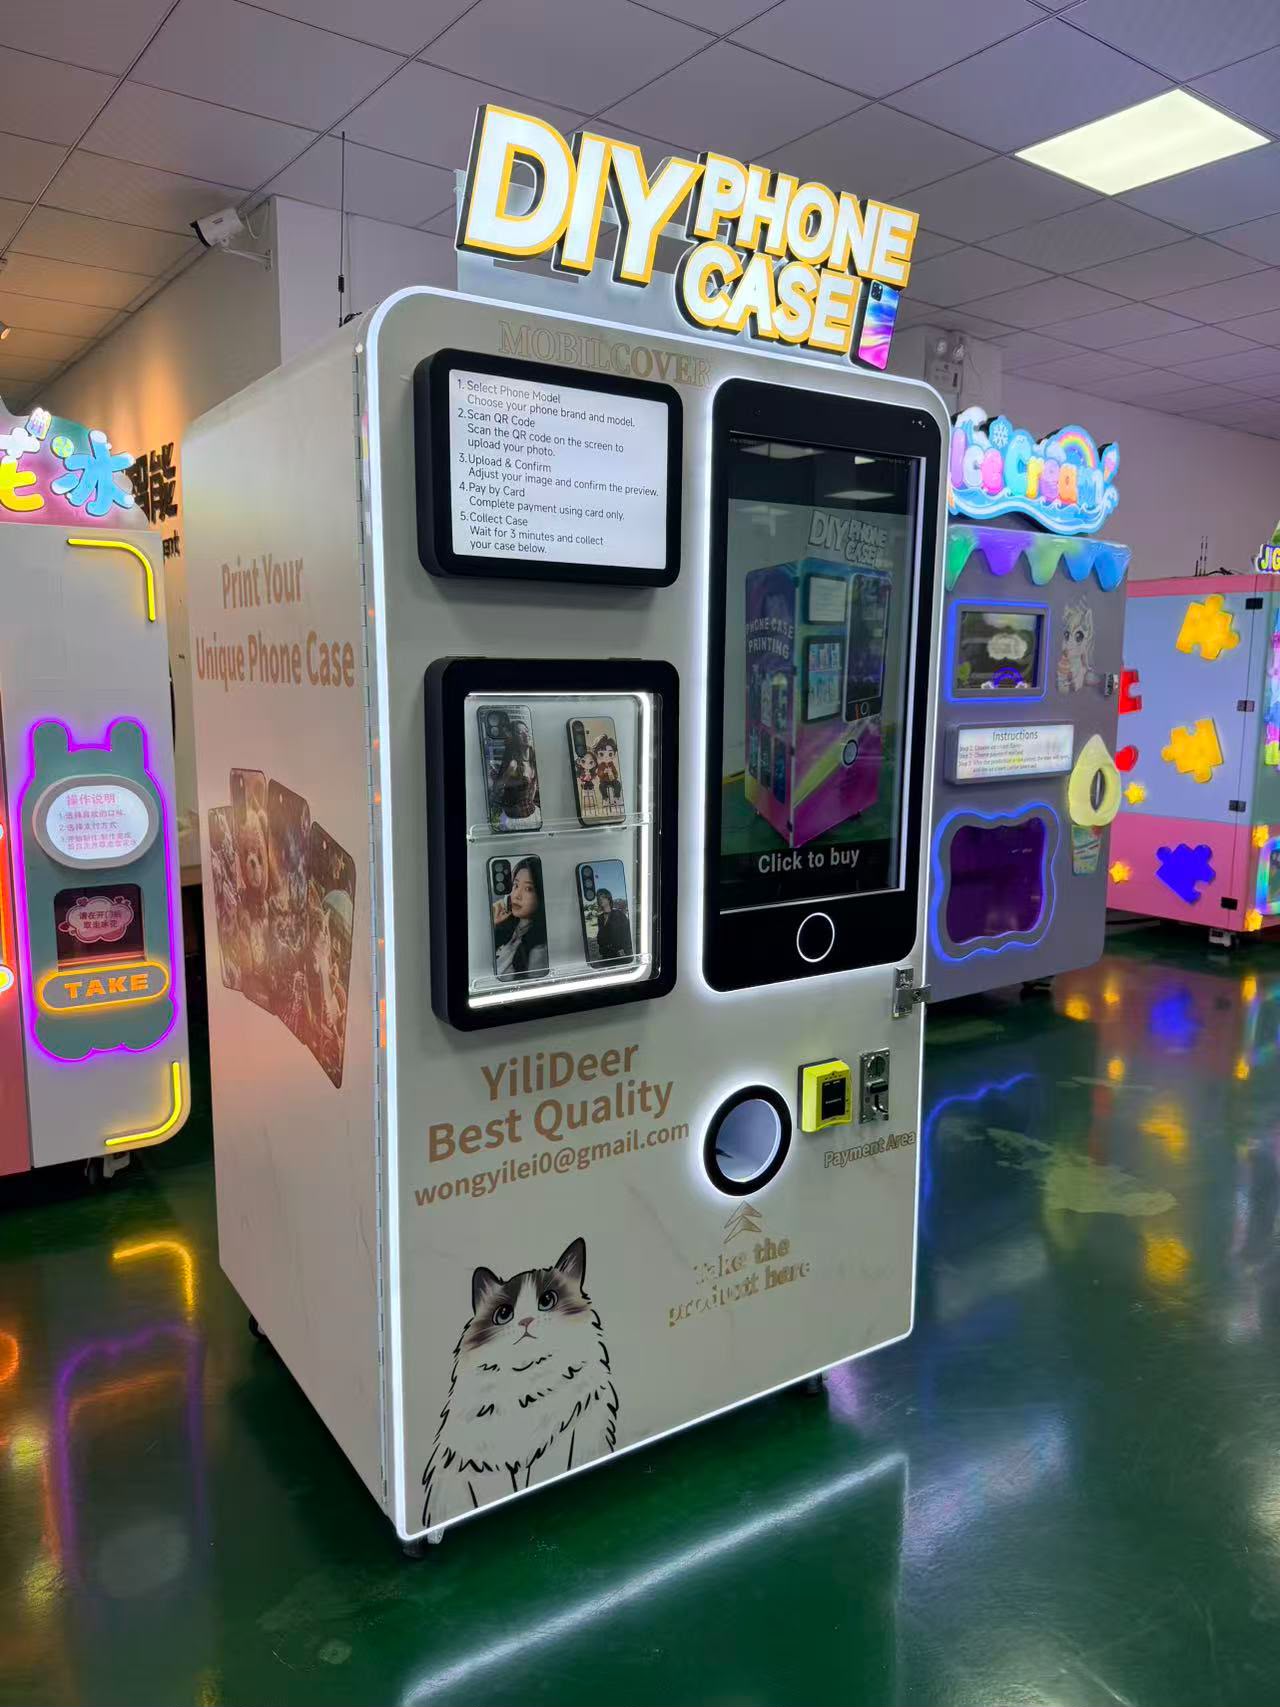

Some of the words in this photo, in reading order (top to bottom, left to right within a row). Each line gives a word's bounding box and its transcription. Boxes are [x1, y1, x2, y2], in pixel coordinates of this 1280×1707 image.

[455, 103, 706, 288] DIY
[686, 151, 920, 290] PHONE
[675, 241, 864, 357] CASE
[467, 380, 498, 395] Select
[500, 385, 530, 399] Phone
[532, 390, 561, 404] Model
[467, 393, 504, 409] Choose
[506, 400, 527, 412] your
[529, 404, 558, 417] phone
[560, 407, 587, 420] brand
[588, 413, 605, 423] and
[607, 416, 636, 428] model.
[493, 412, 509, 425] QR
[511, 415, 536, 428] Code
[467, 422, 491, 436] Scan
[494, 427, 510, 438] the
[512, 428, 527, 441] QR
[529, 432, 552, 444] code
[553, 436, 565, 446] on
[567, 436, 582, 448] the
[584, 440, 613, 452] screen
[615, 443, 624, 453] to
[467, 438, 501, 451] upload
[503, 442, 525, 453] your
[526, 444, 556, 457] photo.
[504, 458, 512, 469] &
[514, 459, 552, 473] Confirm
[950, 427, 1004, 495] Ice
[1004, 434, 1104, 509] Cream
[468, 467, 500, 481] Adjust
[501, 472, 523, 482] your
[525, 472, 553, 487] image
[555, 477, 572, 488] and
[573, 480, 607, 492] confirm
[609, 482, 623, 493] the
[624, 485, 659, 497] preview.
[488, 484, 501, 496] by
[503, 485, 526, 498] Card
[469, 495, 515, 510] Complete
[517, 502, 557, 515] payment
[559, 505, 583, 519] using
[584, 508, 604, 519] card
[605, 509, 625, 522] only.
[505, 515, 529, 527] Case
[469, 525, 492, 537] Wait
[494, 527, 508, 538] for
[510, 528, 517, 539] 3
[518, 529, 555, 543] minutes
[556, 533, 573, 543] and
[575, 535, 605, 546] collect
[808, 509, 850, 552] DIY
[847, 518, 888, 549] PHONE
[469, 540, 492, 551] your
[494, 542, 516, 551] case
[518, 542, 548, 554] below.
[221, 554, 261, 609] Print
[262, 553, 304, 605] Your
[196, 631, 246, 693] Unique
[247, 629, 302, 685] Phone
[306, 629, 355, 688] Case
[748, 637, 790, 660] PRINTING
[992, 730, 1039, 742] Instructions
[758, 850, 803, 874] Click
[807, 851, 825, 869] to
[830, 847, 860, 869] buy
[64, 973, 149, 1000] TAKE
[480, 1044, 640, 1102] YiliDeer
[428, 1109, 522, 1163] Best
[534, 1079, 674, 1142] Quality
[824, 1137, 886, 1169] Payment
[886, 1131, 917, 1151] Area
[414, 1122, 690, 1207] wongyilei0@gmail.com
[753, 1237, 791, 1265] the
